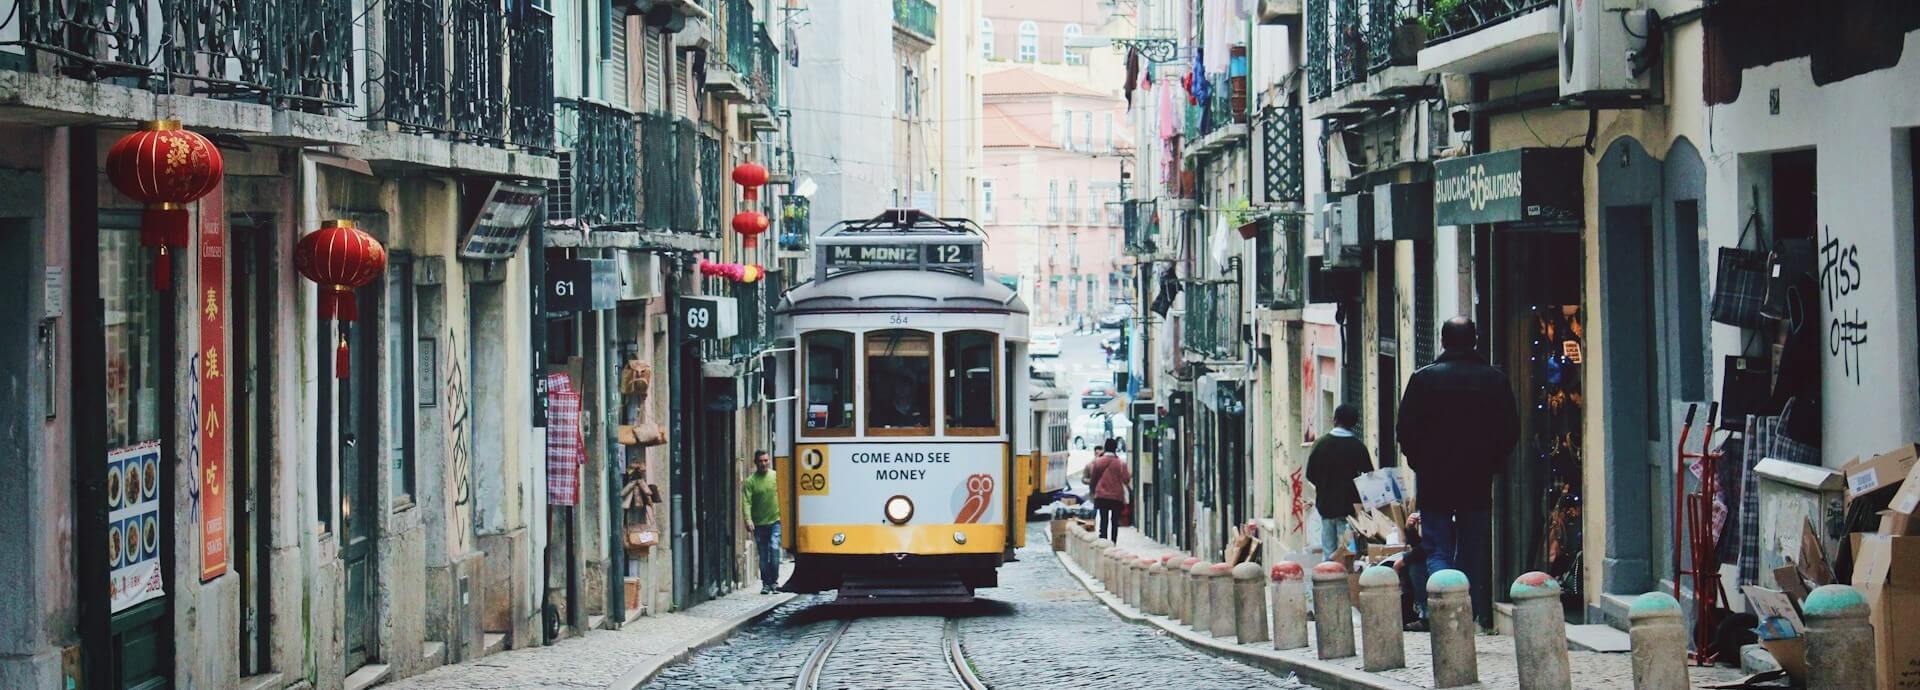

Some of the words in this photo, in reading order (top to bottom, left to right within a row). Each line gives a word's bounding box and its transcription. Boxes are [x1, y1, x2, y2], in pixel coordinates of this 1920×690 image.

[1469, 164, 1485, 211] 56
[834, 246, 852, 259] M.
[861, 246, 917, 260] MONIZ
[937, 245, 961, 263] 12
[555, 280, 575, 296] 61
[687, 307, 709, 328] 69
[889, 315, 908, 325] 564
[851, 452, 891, 464] COME
[894, 452, 924, 464] AND
[927, 452, 951, 464] SEE
[875, 469, 927, 481] MONEY
